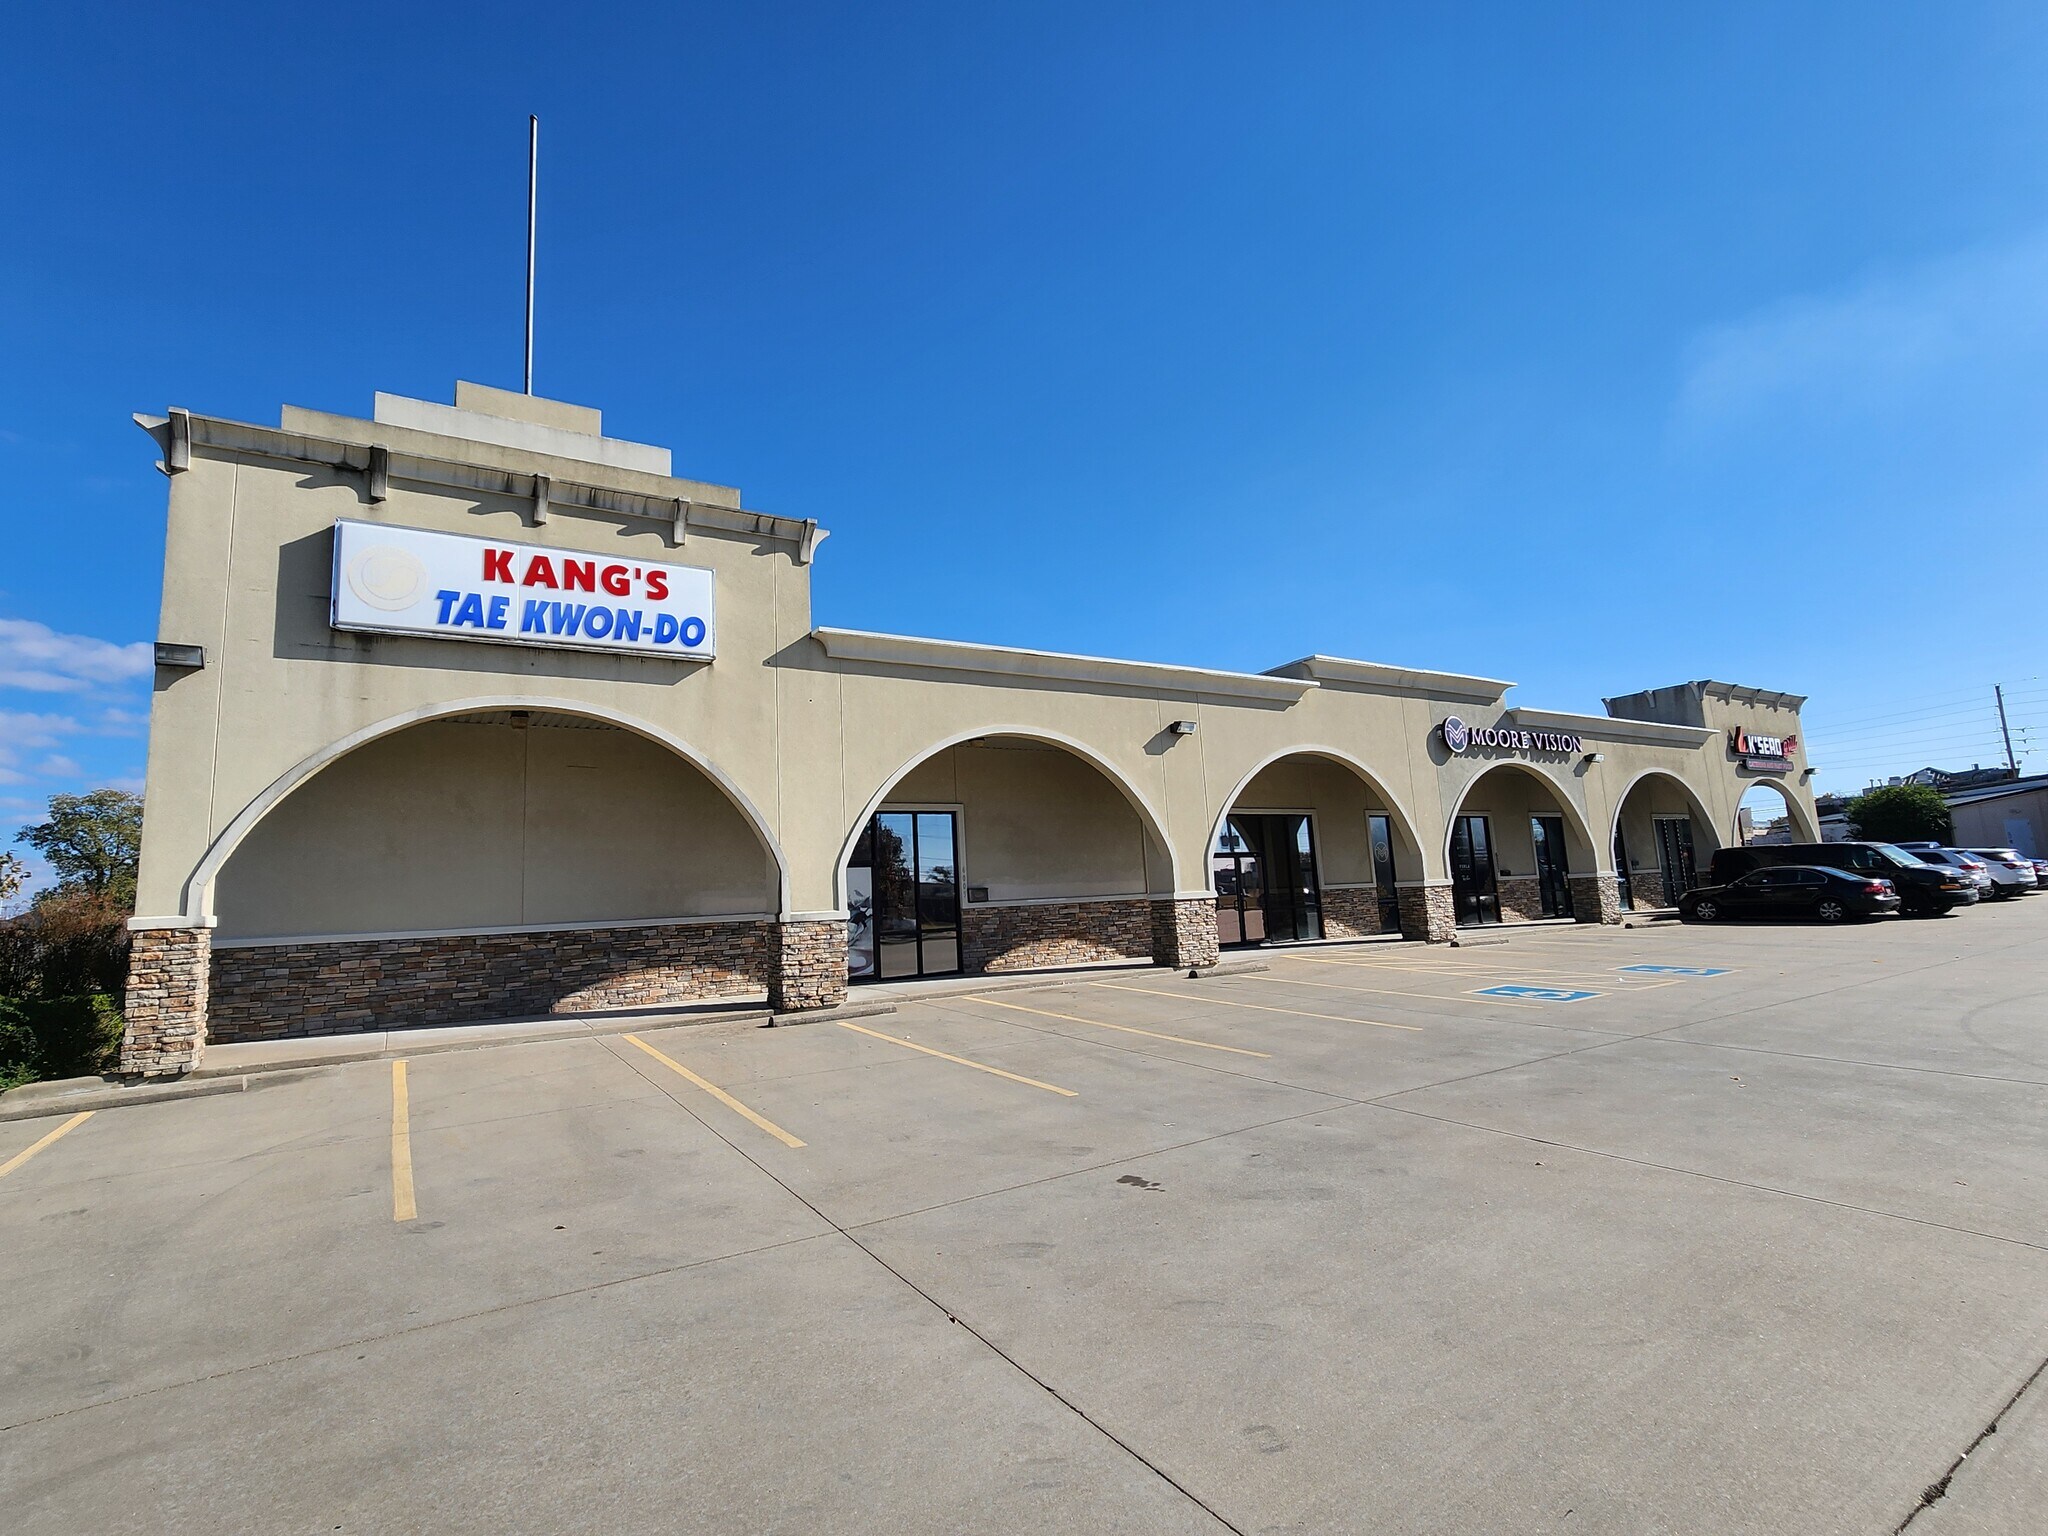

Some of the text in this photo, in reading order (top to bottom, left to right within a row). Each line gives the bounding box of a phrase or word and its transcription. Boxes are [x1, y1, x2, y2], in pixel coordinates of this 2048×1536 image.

[483, 548, 669, 601] KANG'S
[434, 589, 706, 648] TAE KWON-DO
[1471, 728, 1583, 753] MOORE VISION
